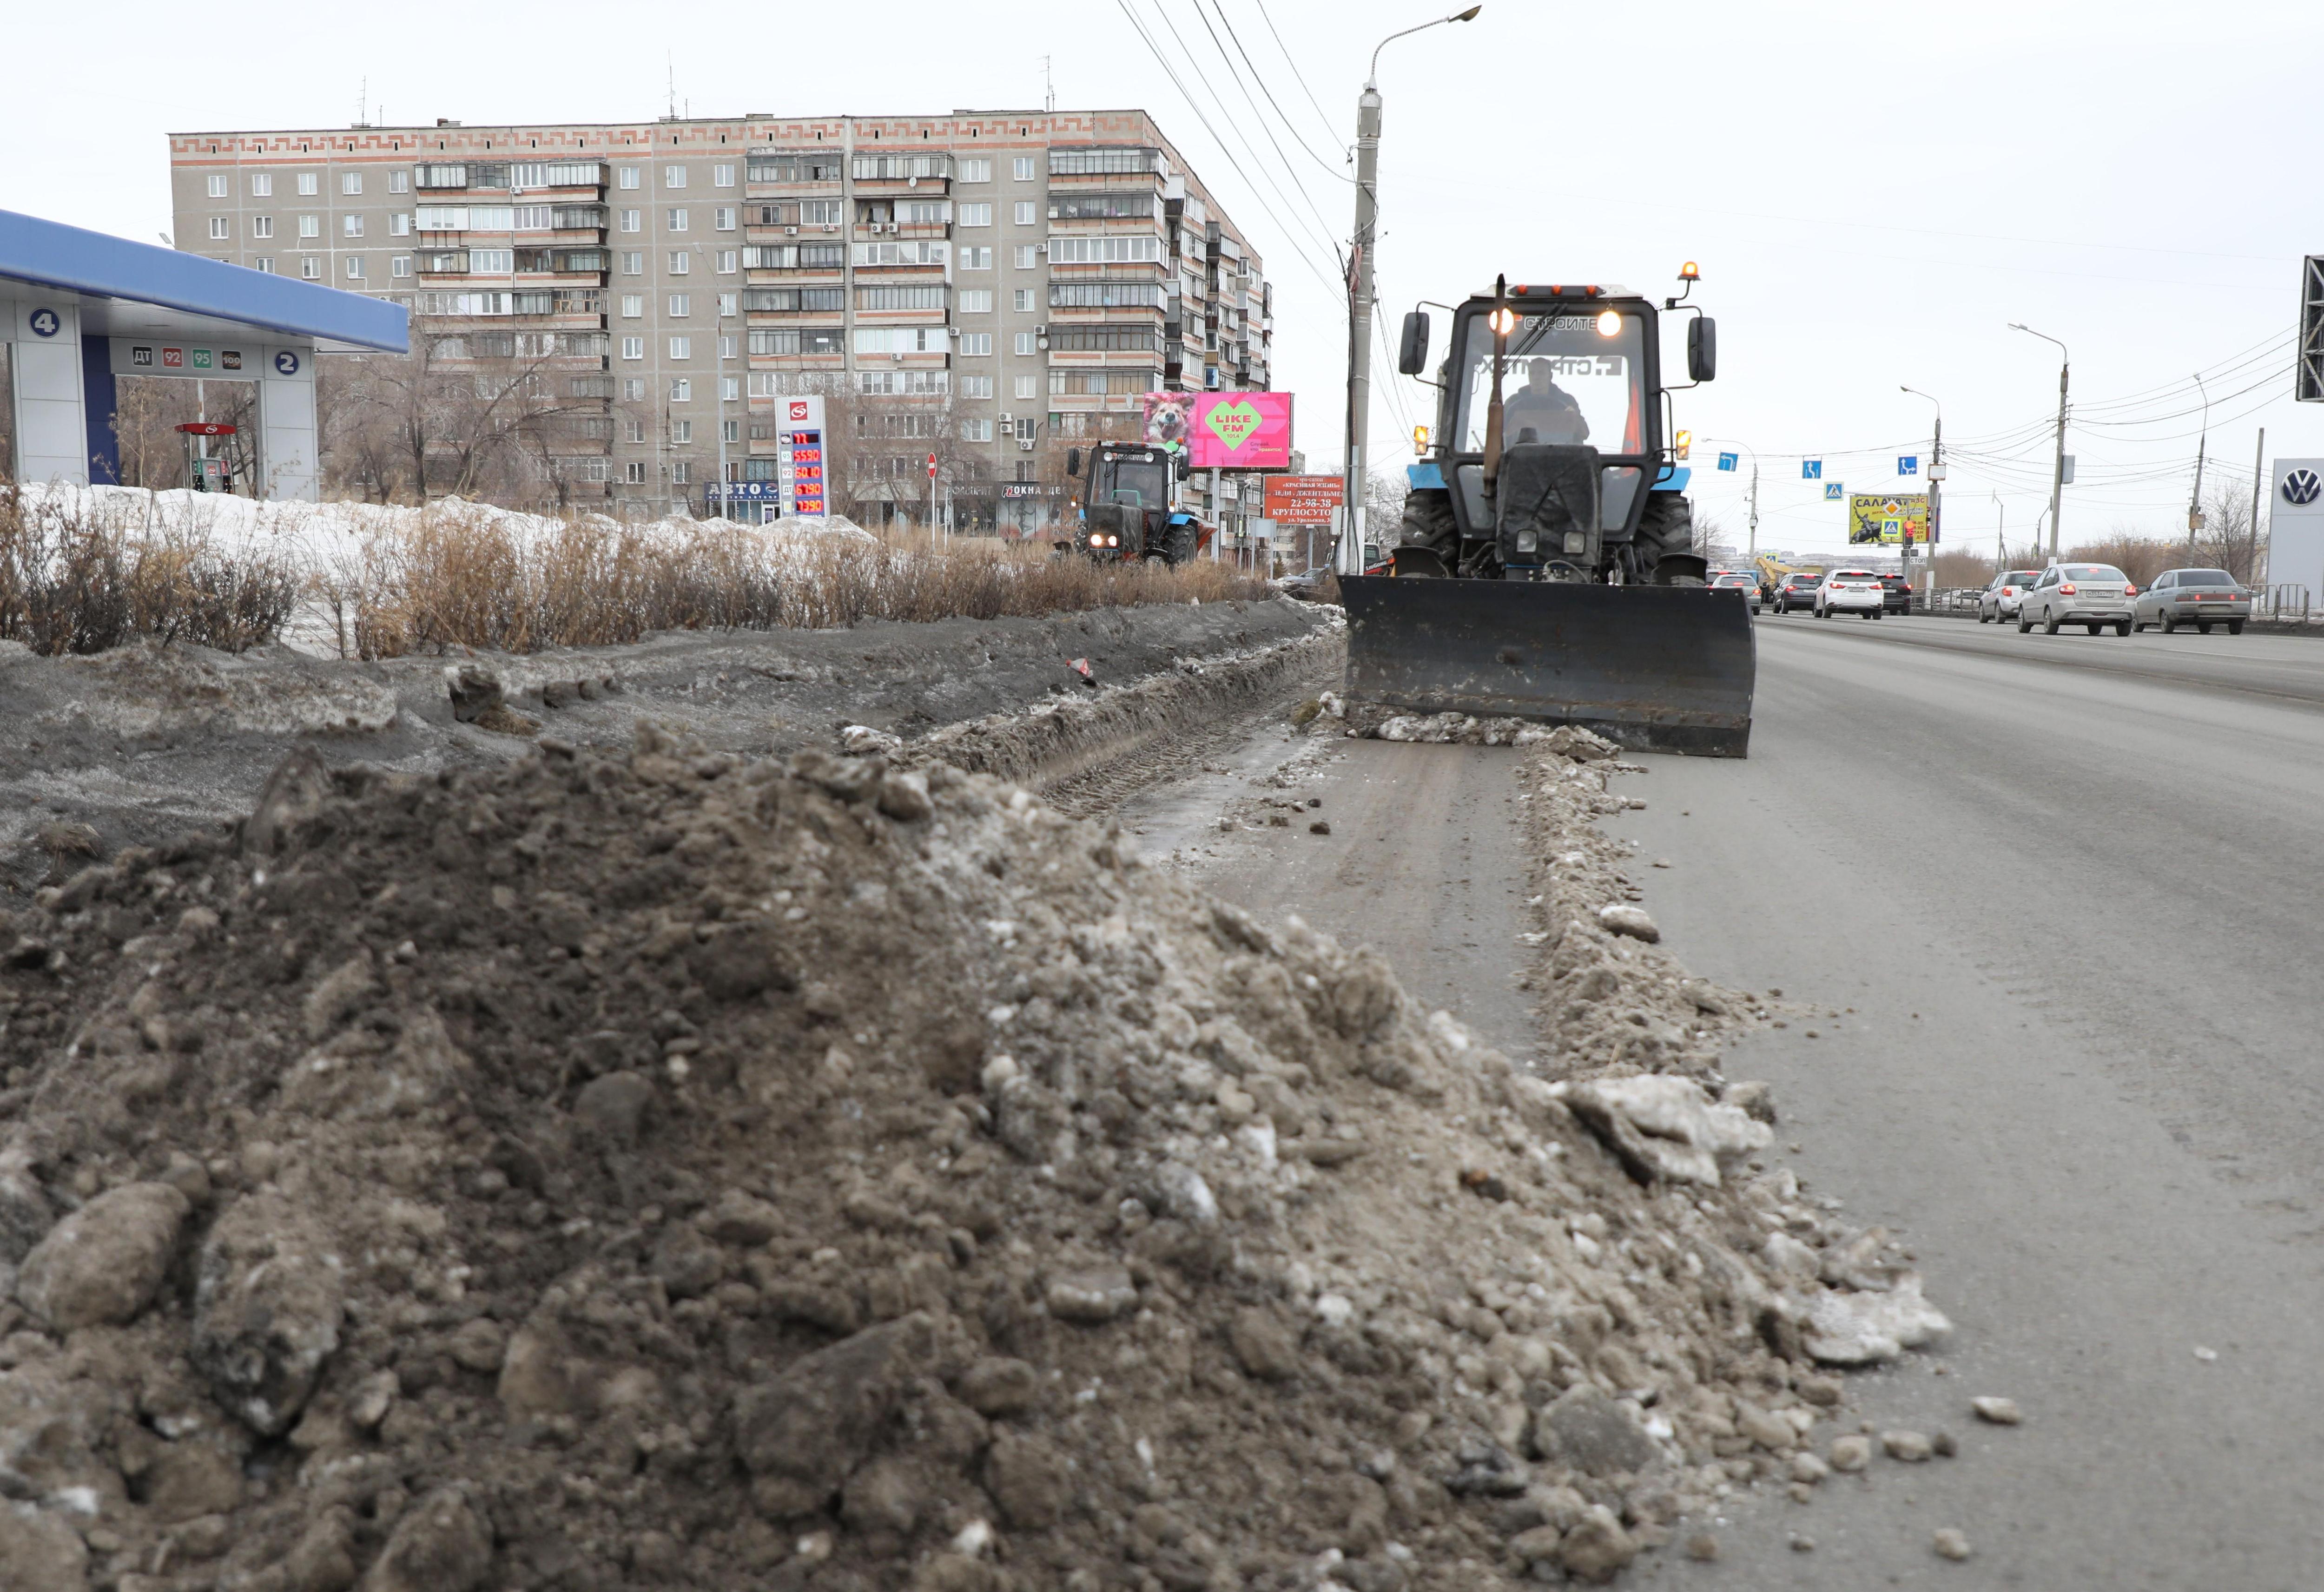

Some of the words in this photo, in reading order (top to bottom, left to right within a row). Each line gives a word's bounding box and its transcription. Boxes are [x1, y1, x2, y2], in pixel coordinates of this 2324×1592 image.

[35, 313, 55, 332] 4
[134, 351, 151, 363] ДТ
[165, 352, 181, 363] 92
[195, 353, 210, 364] 95
[223, 356, 240, 365] 100
[280, 355, 294, 371] 2
[709, 483, 761, 495] АВТО
[1014, 486, 1041, 494] ОКНА
[1291, 499, 1331, 507] 22-98-38
